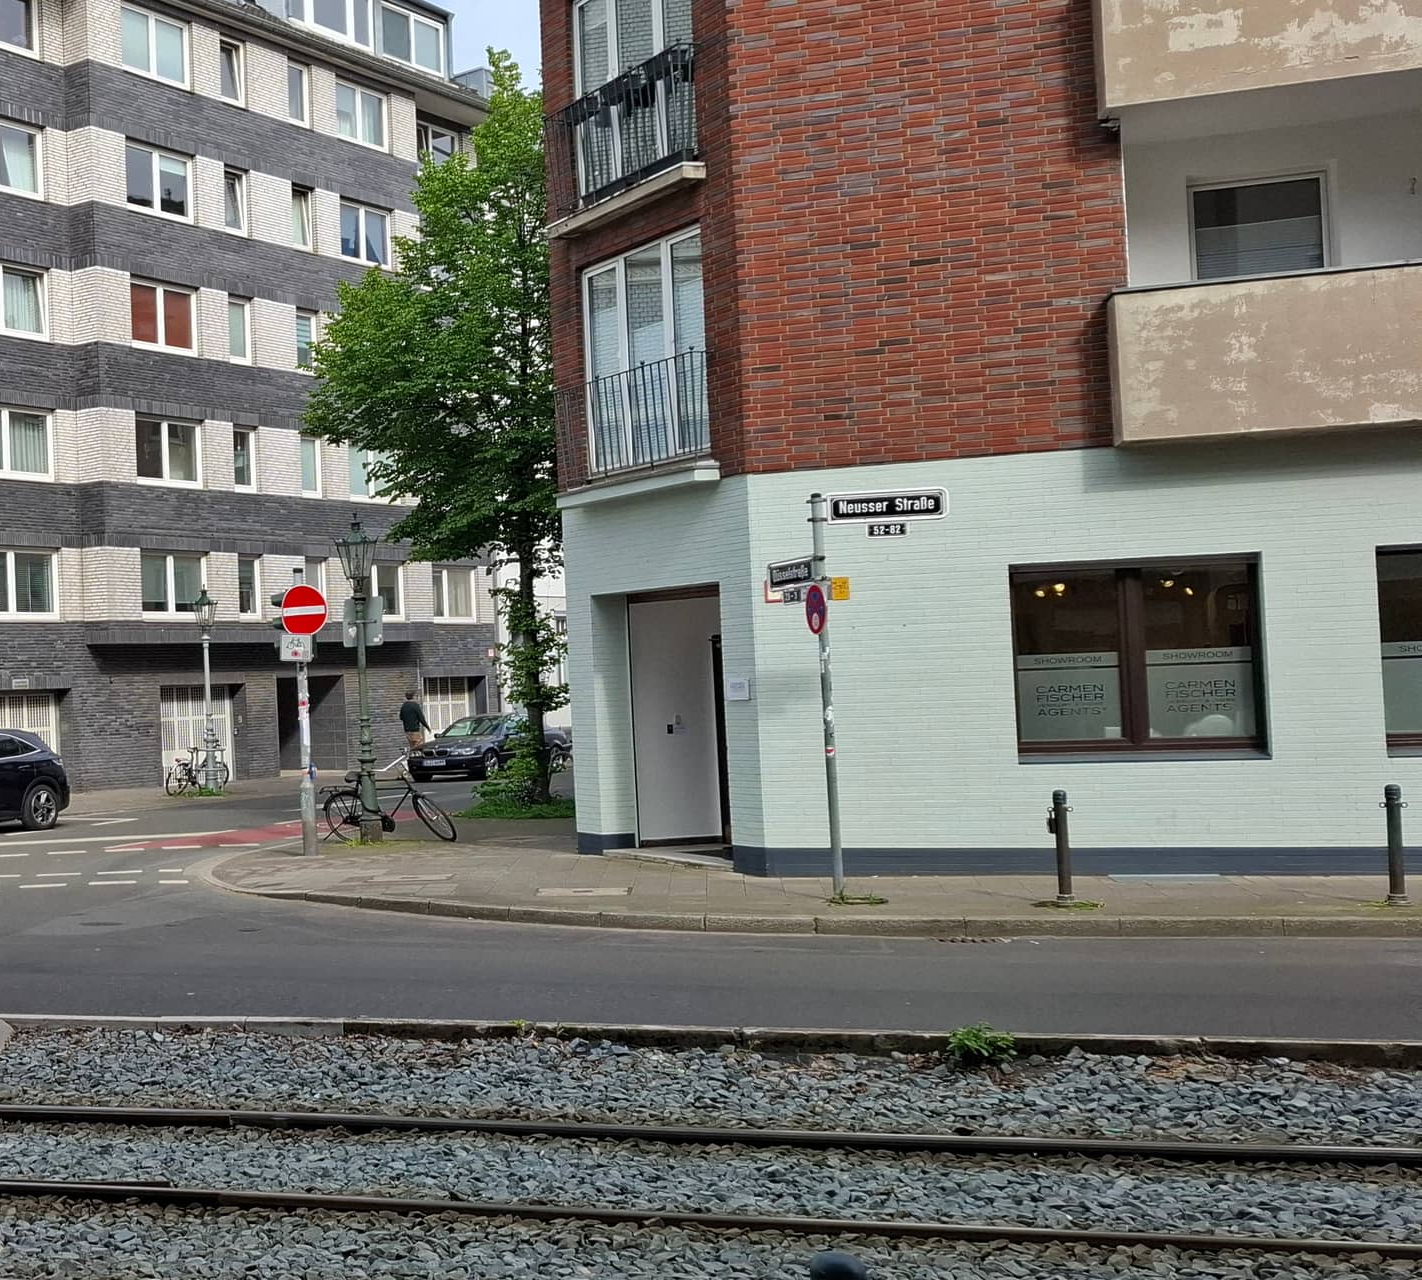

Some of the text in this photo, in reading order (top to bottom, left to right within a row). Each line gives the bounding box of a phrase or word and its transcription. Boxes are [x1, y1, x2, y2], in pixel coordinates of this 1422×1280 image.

[838, 497, 936, 514] Neusser Straße
[872, 524, 902, 535] 52-82
[1033, 655, 1103, 665] SHOWROOM
[1162, 650, 1234, 661] SHOWROOM
[1035, 684, 1105, 694] CARMEN
[1164, 679, 1236, 690] CARMEN
[1036, 693, 1105, 703] FISCHER
[1165, 688, 1237, 698] FISCHER
[1037, 706, 1102, 717] AGENTS
[1166, 703, 1234, 713] AGENTS
